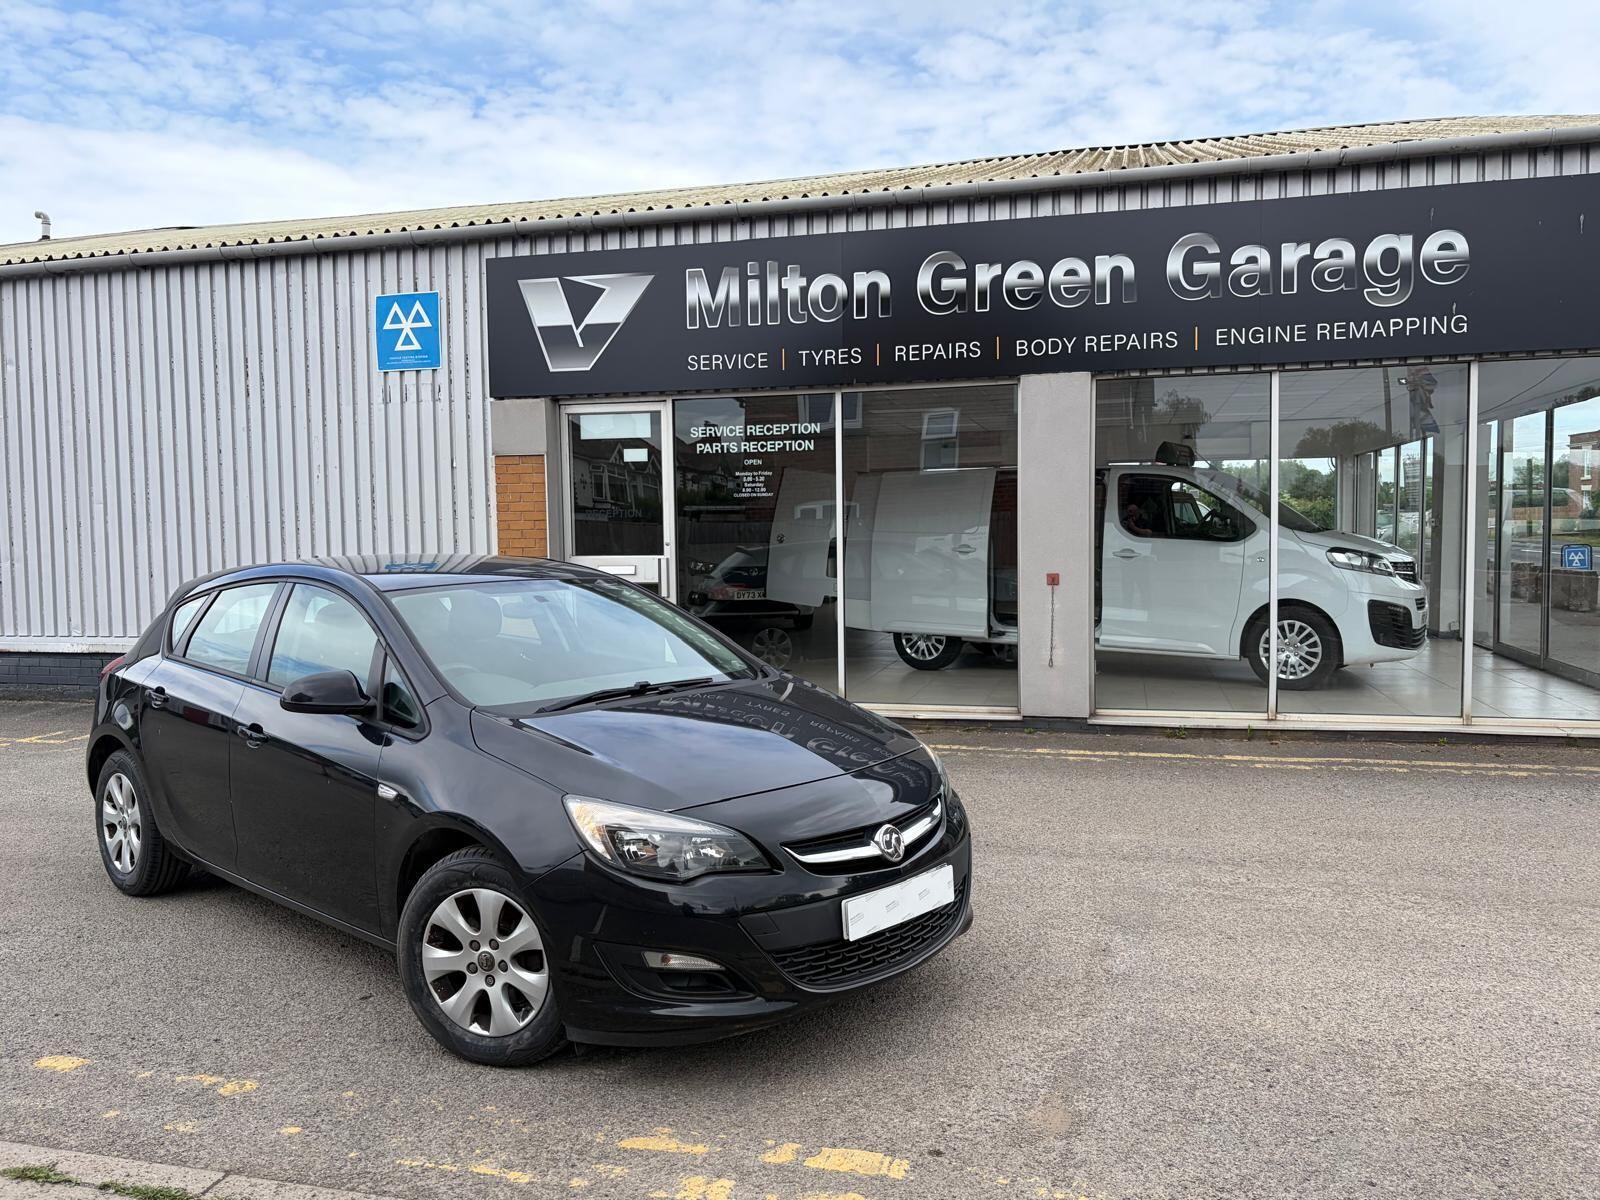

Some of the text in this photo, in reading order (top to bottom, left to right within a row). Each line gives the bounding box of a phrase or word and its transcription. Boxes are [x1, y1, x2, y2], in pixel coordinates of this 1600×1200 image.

[686, 228, 1470, 329] Milton Green Garage
[687, 314, 1469, 371] SERVICE TYRES REPAIRS BODY REPAIRS ENGINE REMAPPING
[690, 423, 820, 438] SERVICE RECEPTION
[696, 440, 814, 454] PARTS RECEPTION
[585, 509, 642, 518] RECEPTION
[736, 591, 756, 599] DY73
